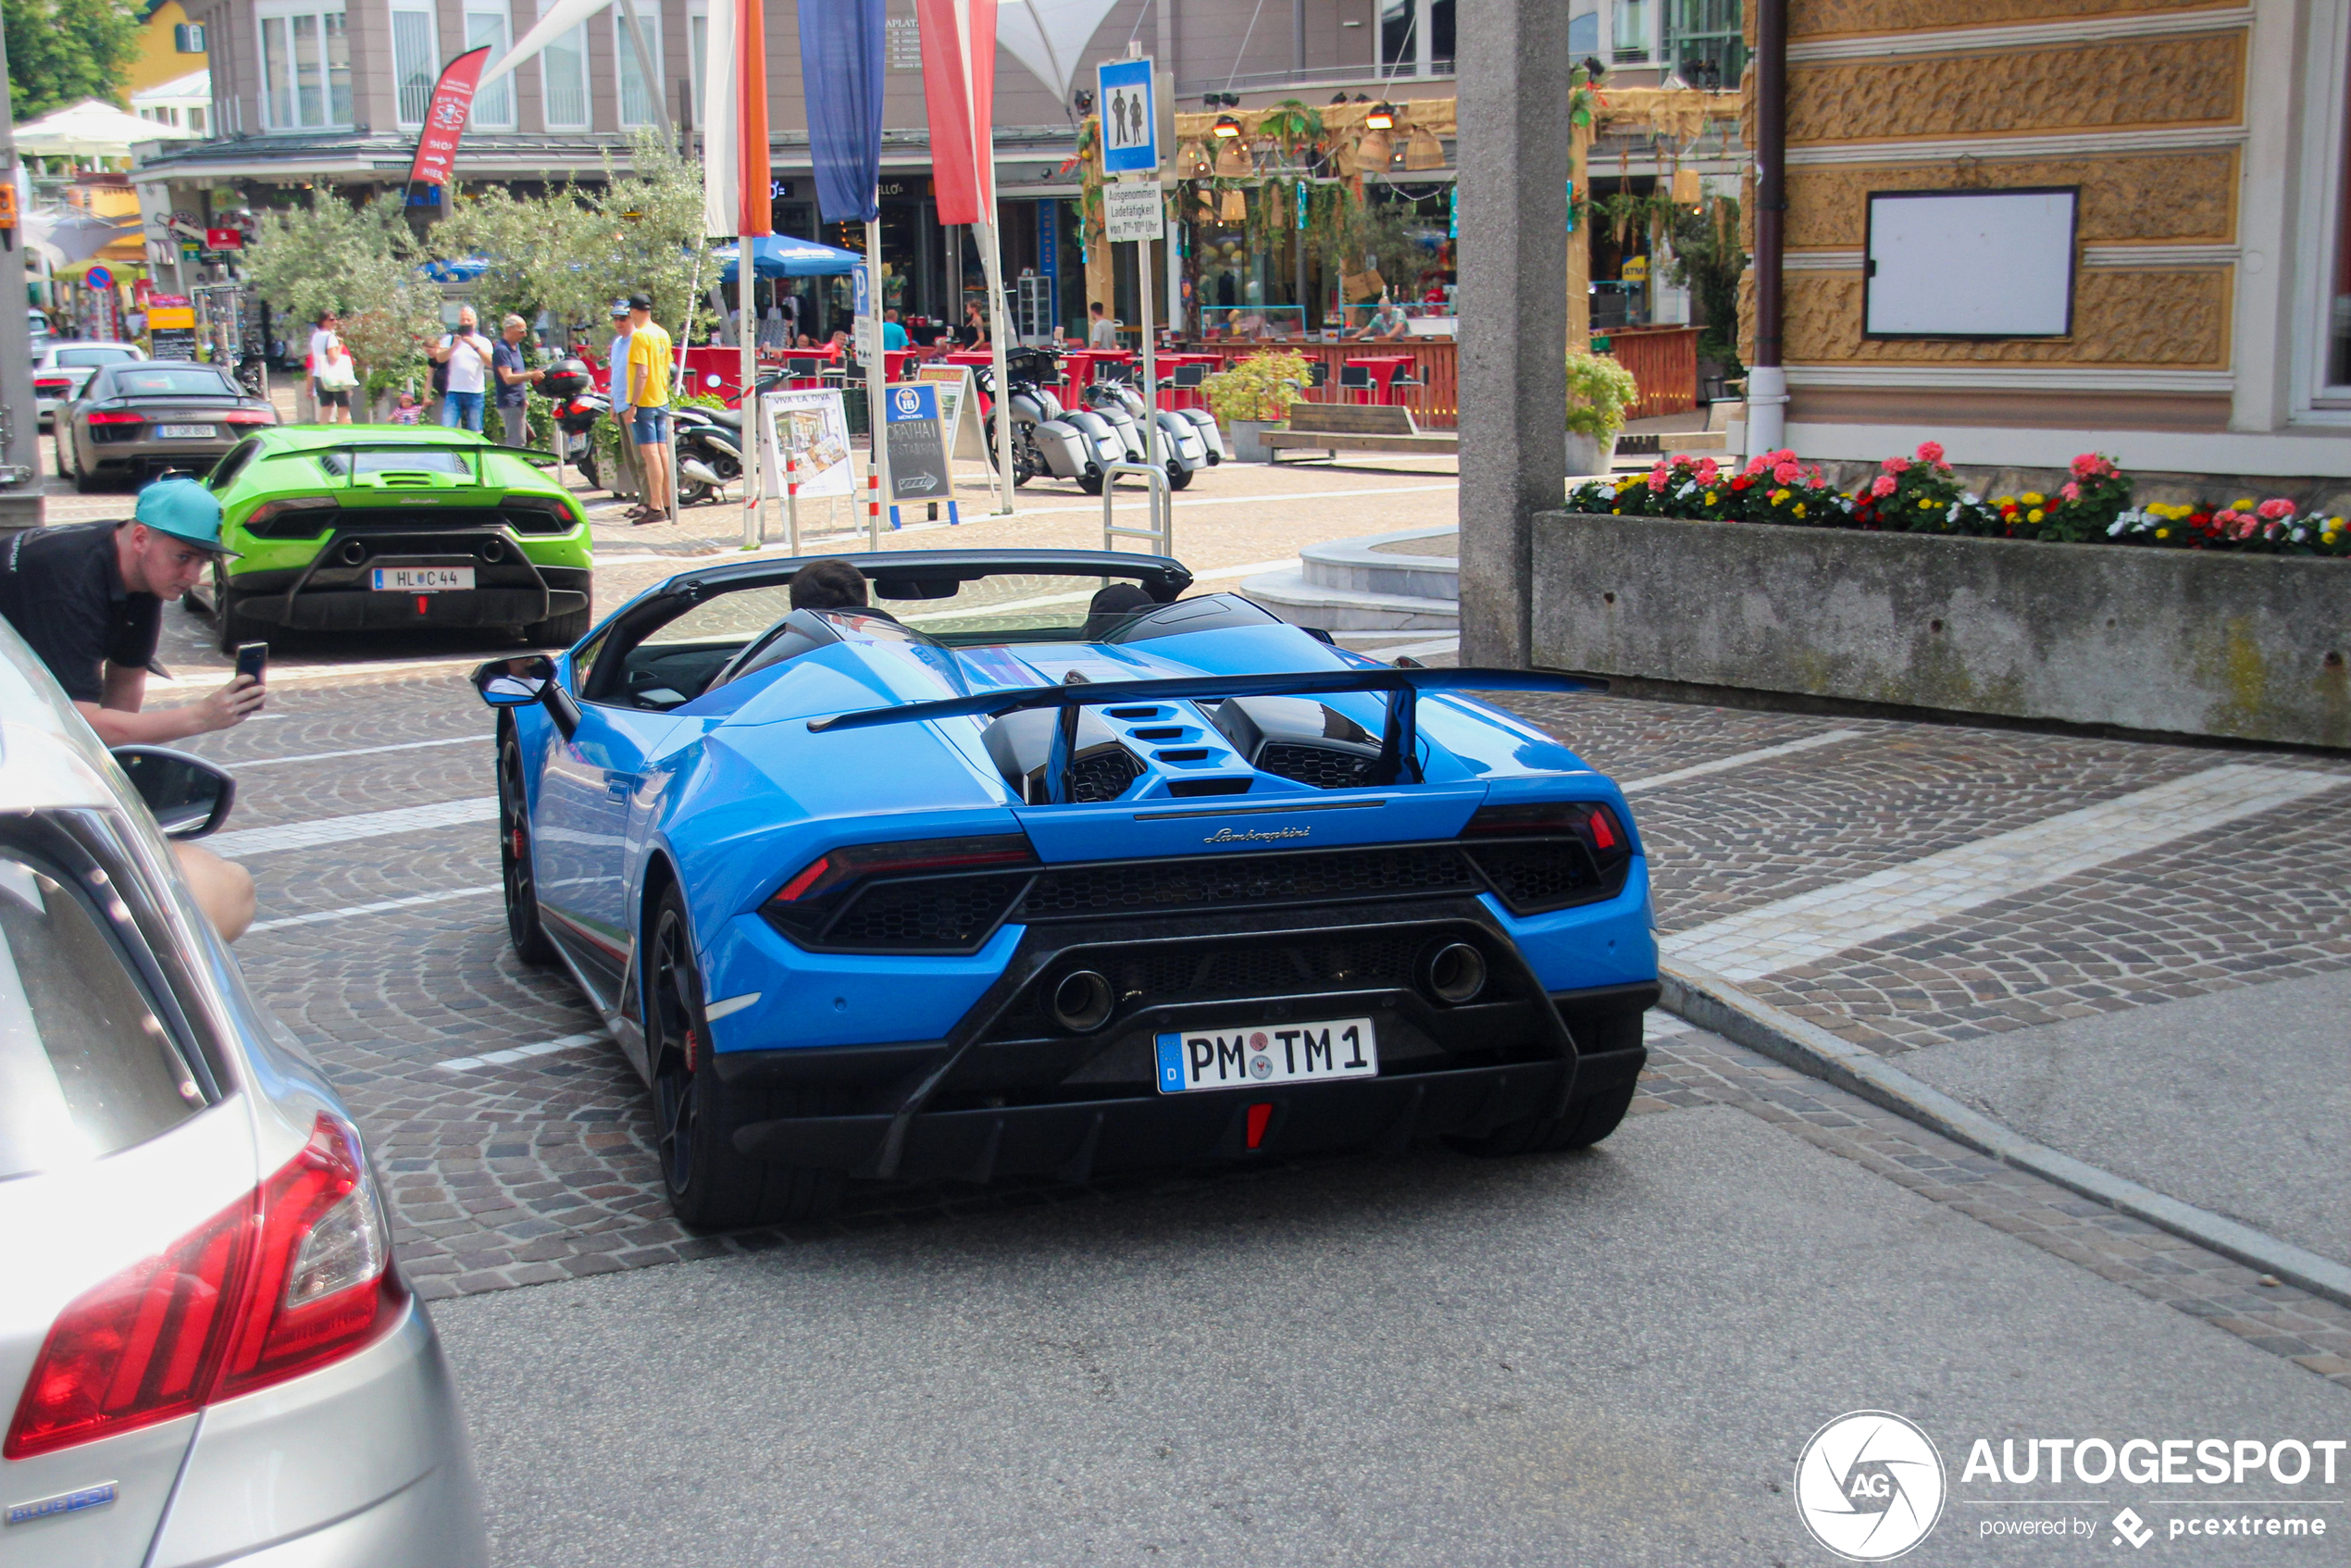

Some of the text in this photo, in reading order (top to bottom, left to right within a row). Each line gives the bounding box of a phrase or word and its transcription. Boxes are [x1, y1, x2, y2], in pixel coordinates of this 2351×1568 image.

[886, 19, 919, 28] APLAT
[429, 140, 453, 151] SHOP
[422, 167, 443, 179] HIER
[1109, 188, 1157, 203] Ausgenommen
[1111, 203, 1155, 219] Ladetätigkeit
[1110, 223, 1122, 234] von
[1146, 219, 1158, 233] Uhr
[855, 268, 866, 312] P
[774, 392, 831, 405] VIVA LA DIVA
[397, 571, 415, 586] HL
[427, 570, 436, 585] C
[440, 570, 458, 585] 44
[1203, 826, 1312, 843] Lamborghini
[1166, 1067, 1177, 1081] D
[1187, 1034, 1246, 1082] PM
